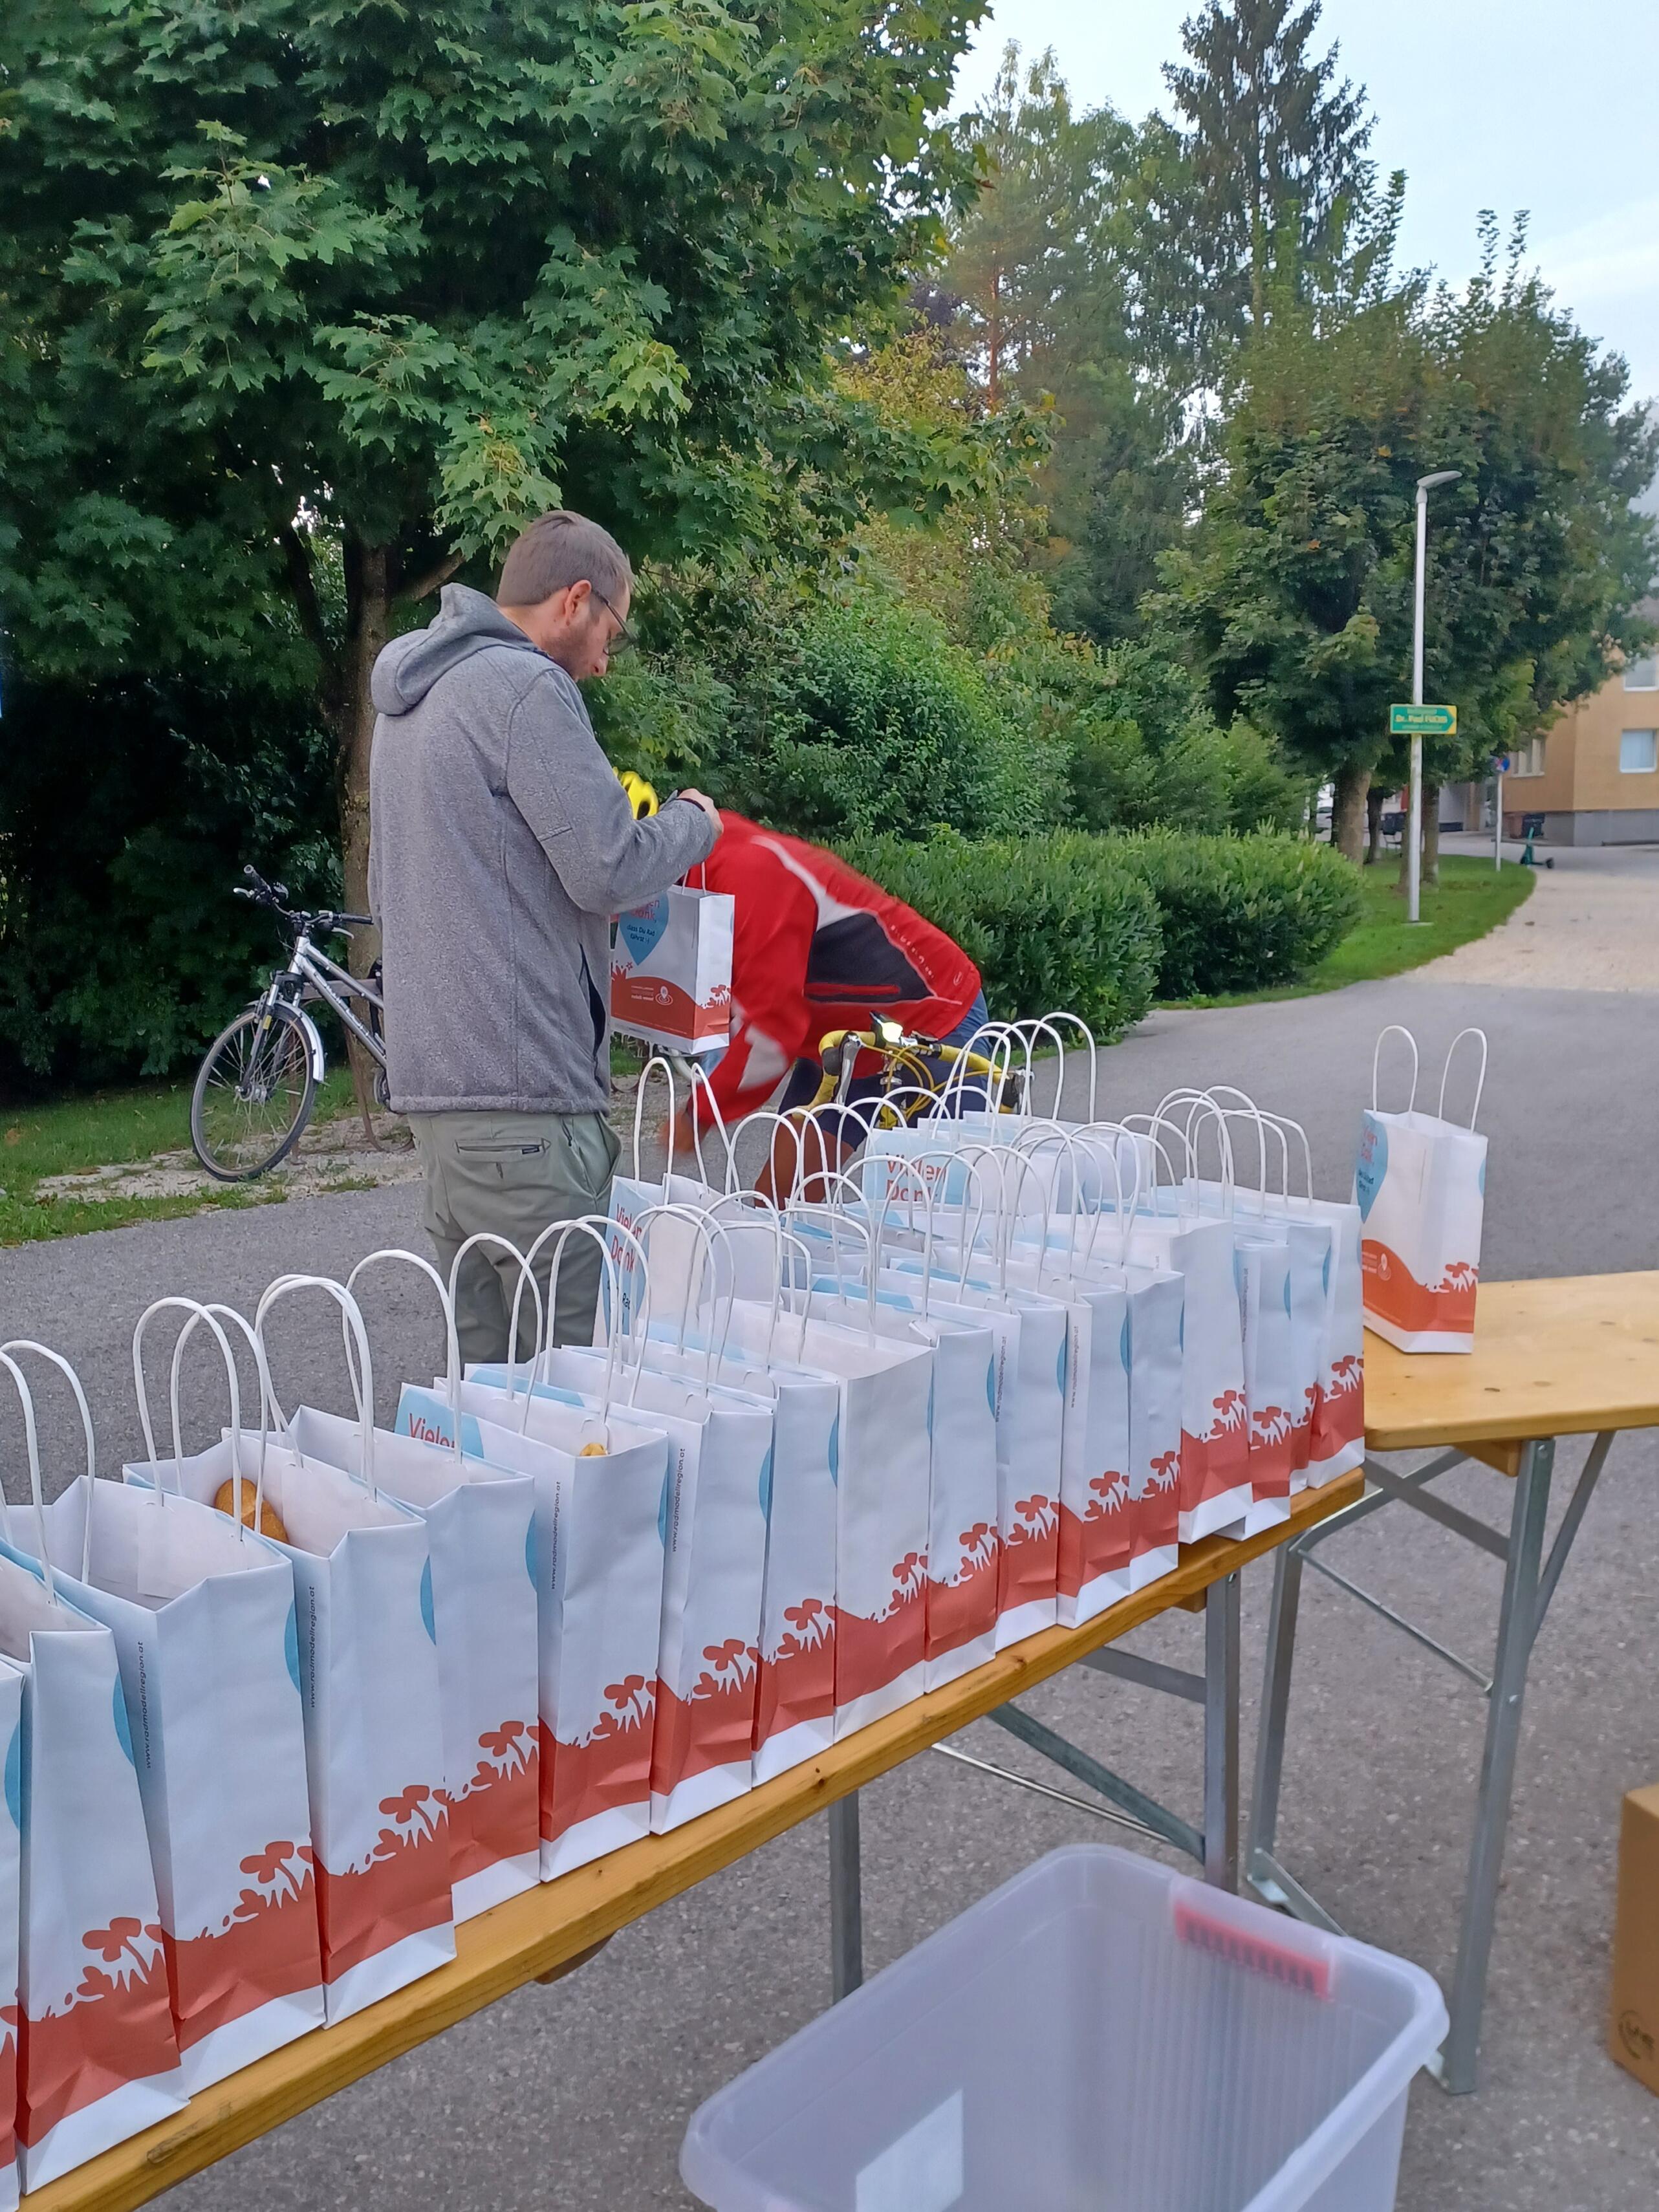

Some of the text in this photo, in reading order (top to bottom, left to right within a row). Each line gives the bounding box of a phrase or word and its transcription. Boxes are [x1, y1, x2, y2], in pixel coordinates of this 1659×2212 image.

[885, 1153, 947, 1184] Vilen
[672, 1448, 686, 1552] www.radmodellregion.at
[309, 1586, 317, 1708] www.radmodellregion.at
[138, 1641, 151, 1769] www.radmodellregion.at
